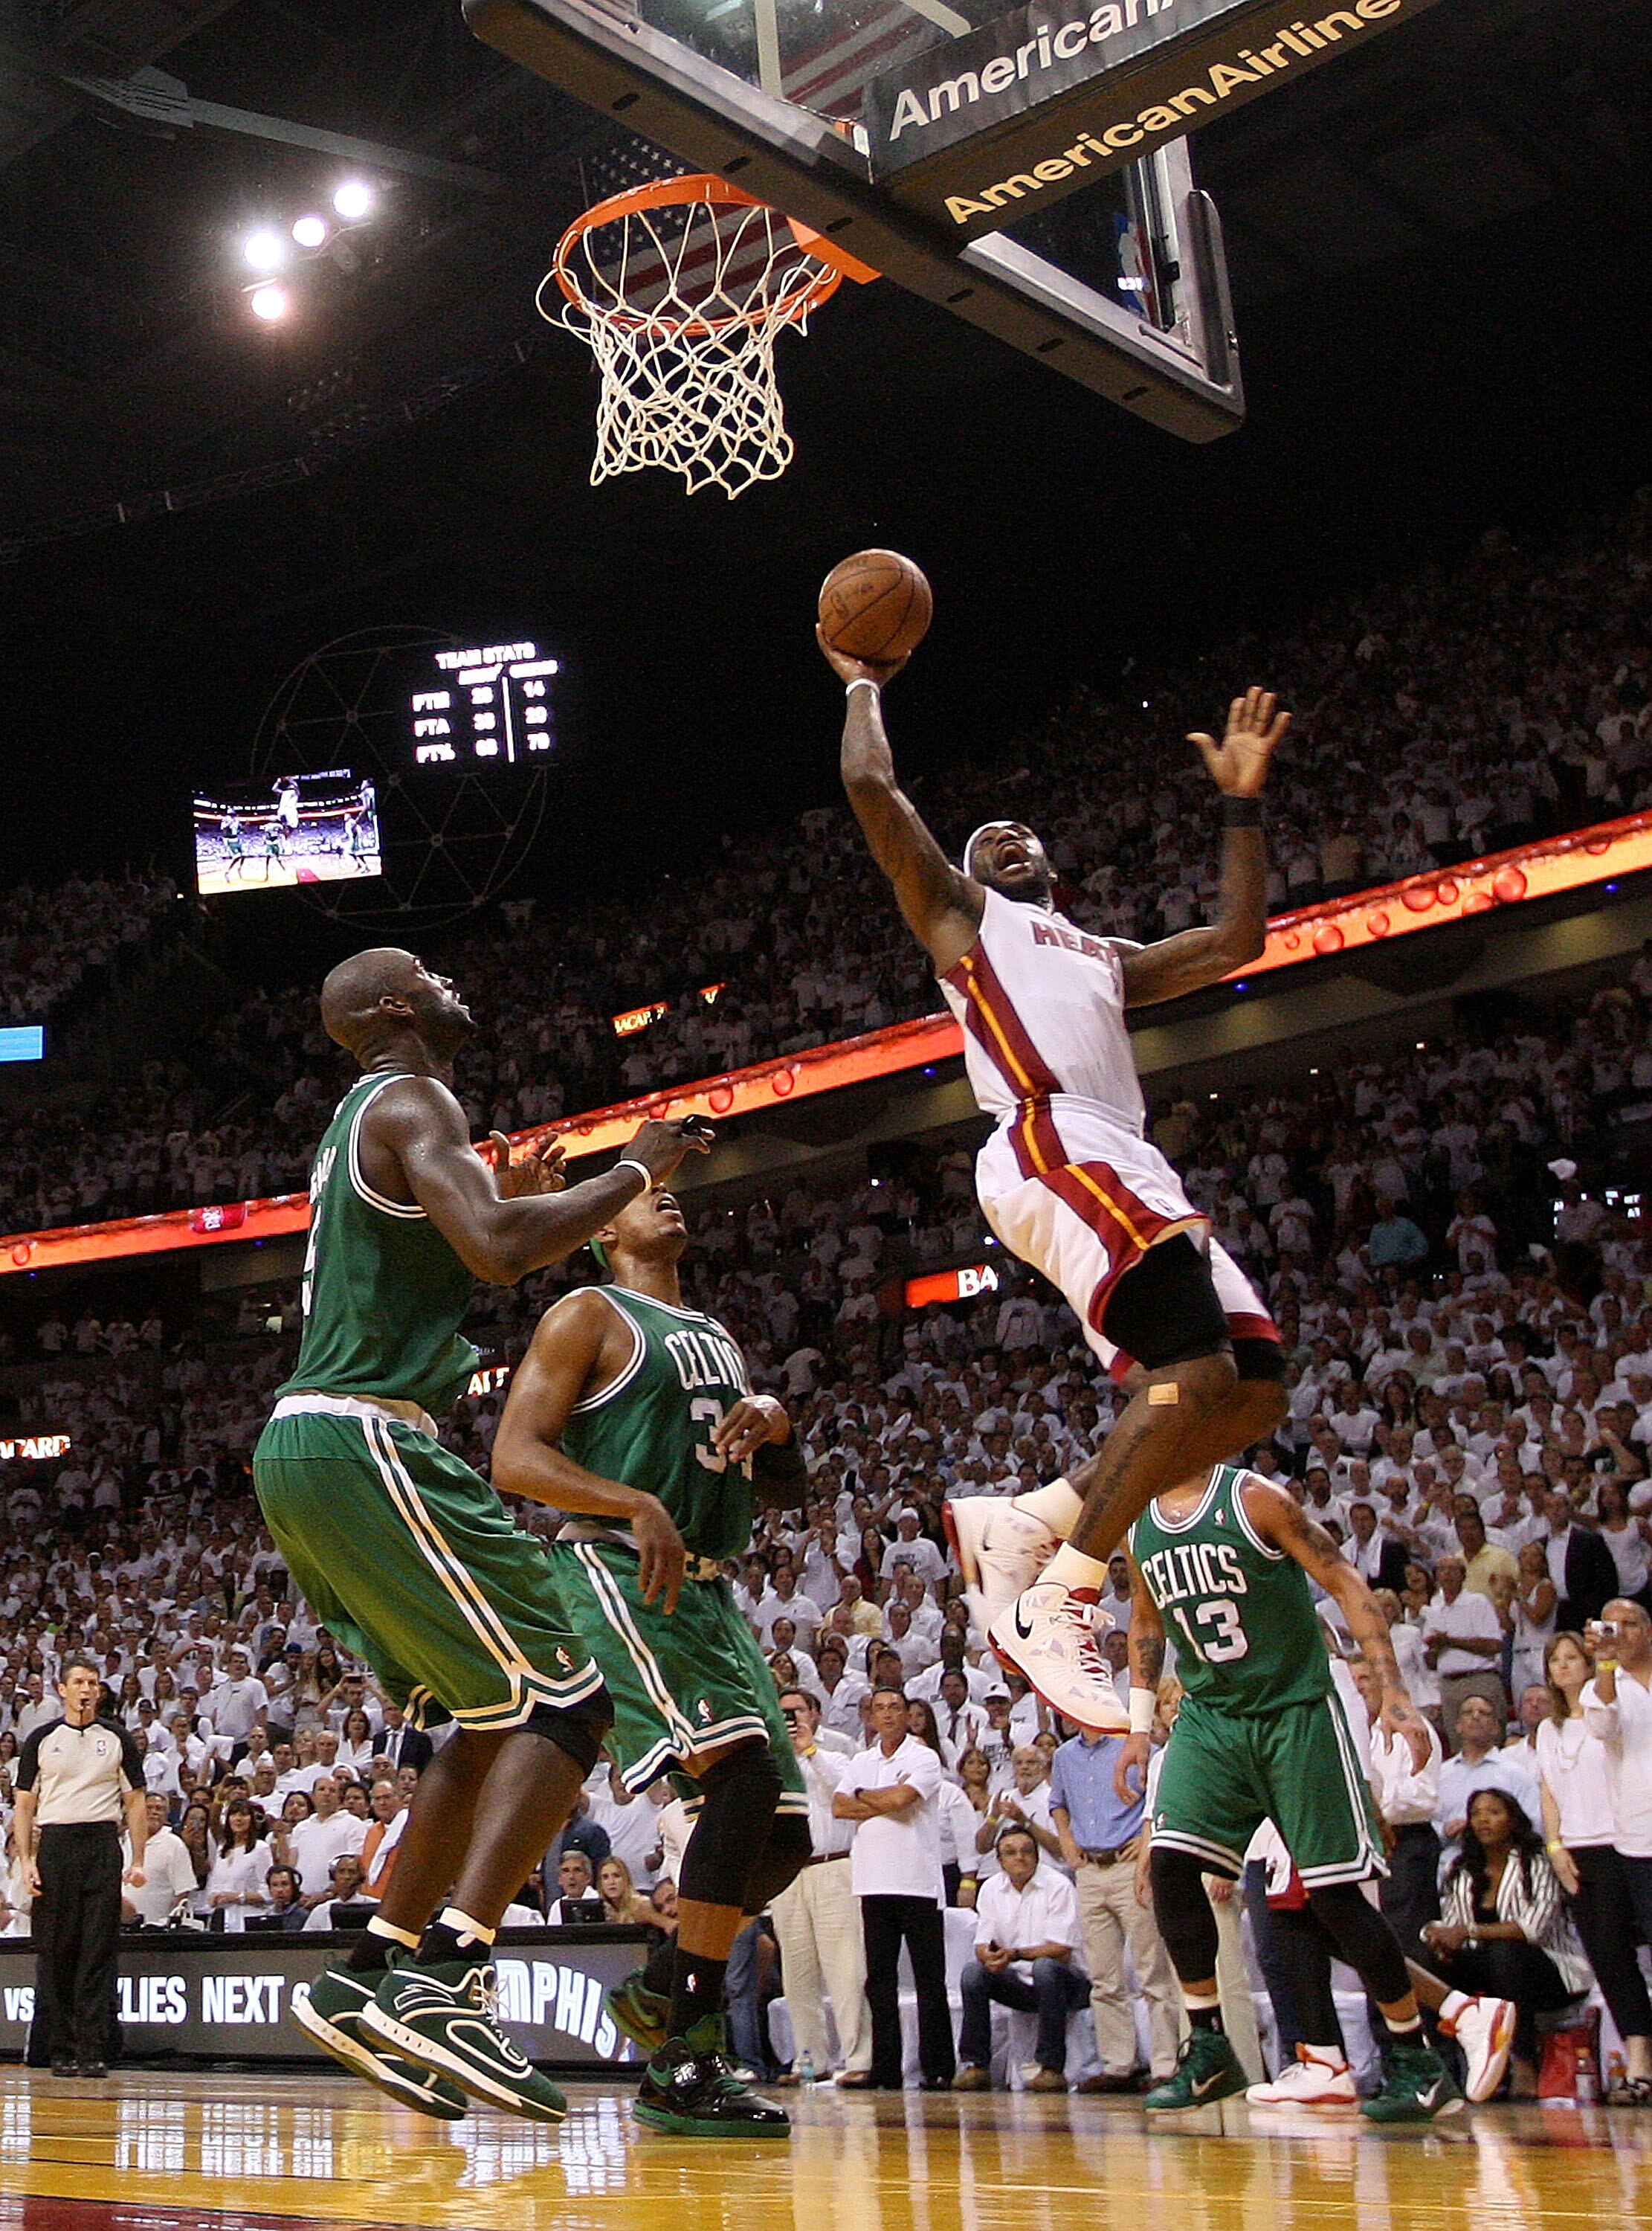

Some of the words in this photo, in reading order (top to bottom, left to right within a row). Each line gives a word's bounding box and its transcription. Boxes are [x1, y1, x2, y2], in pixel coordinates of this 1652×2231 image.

[889, 0, 1172, 141] American
[413, 718, 451, 738] FTA
[1140, 1543, 1248, 1610] CELTICS
[1172, 1598, 1249, 1664] 13
[201, 1975, 285, 2024] NEXT
